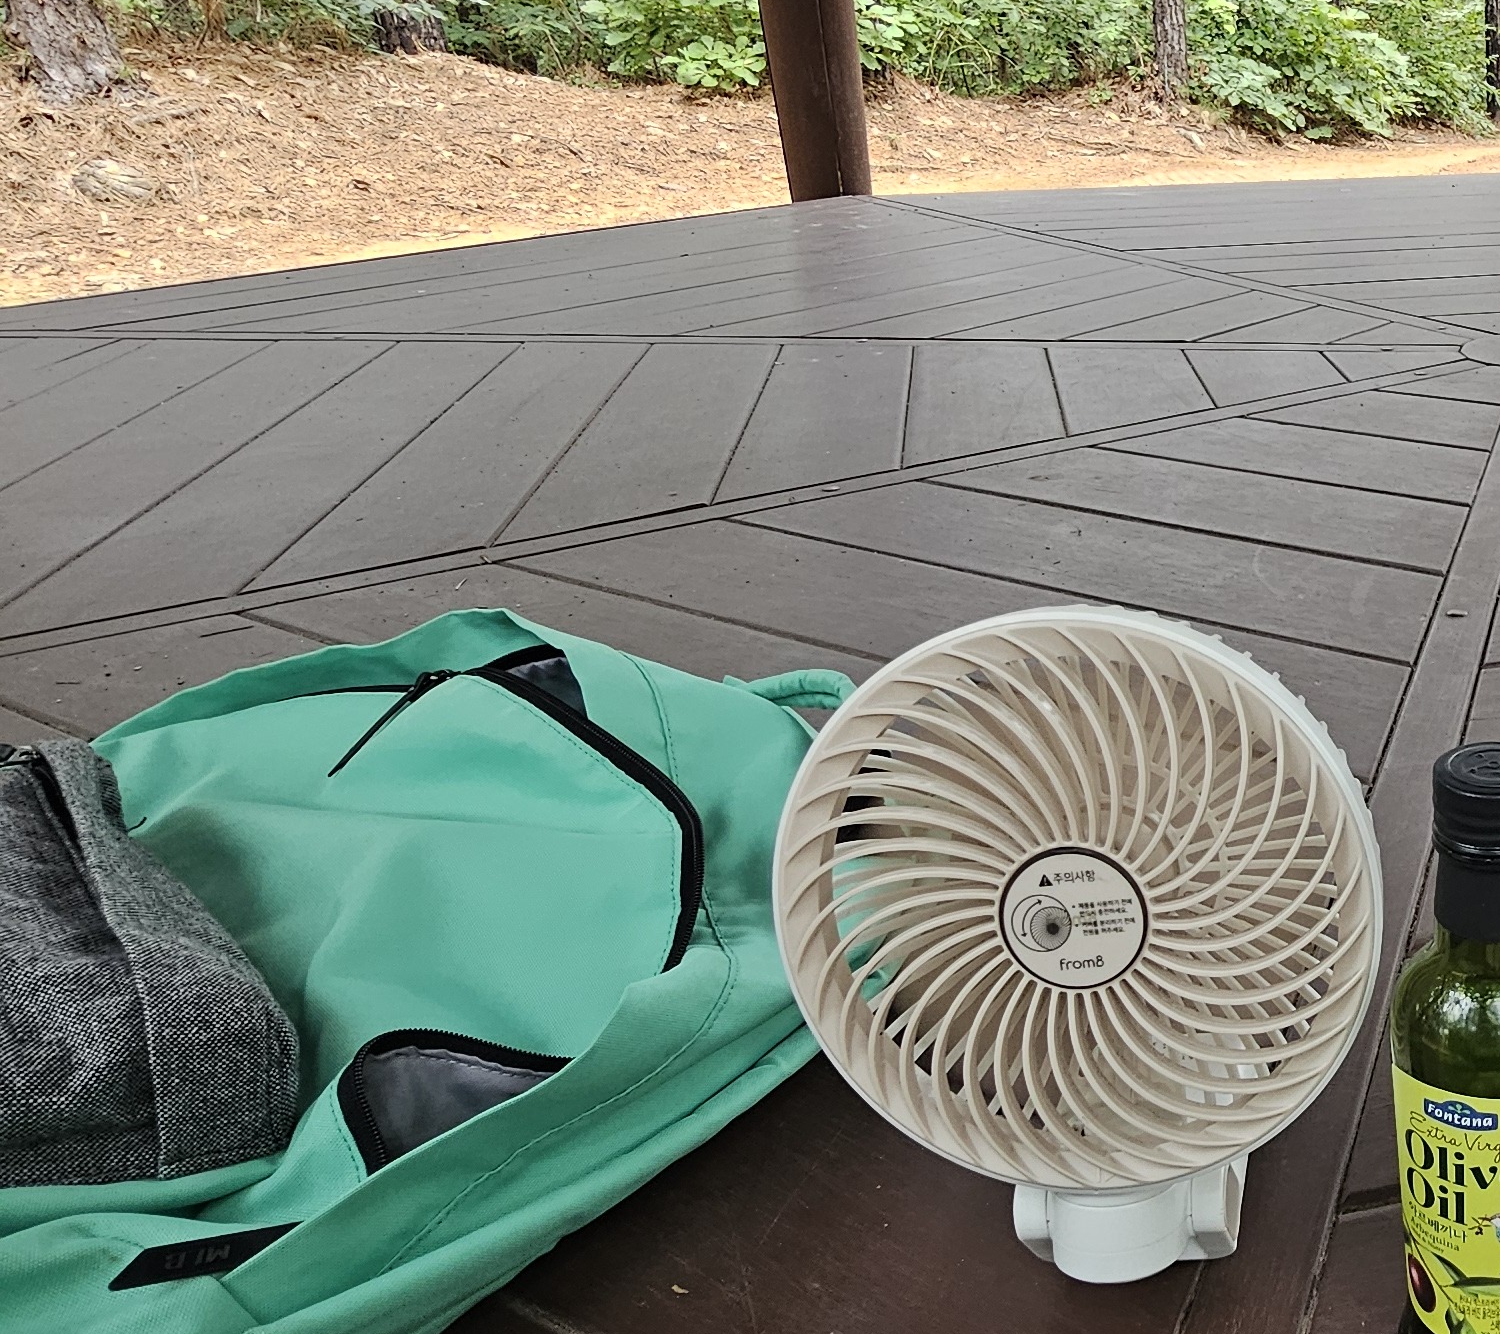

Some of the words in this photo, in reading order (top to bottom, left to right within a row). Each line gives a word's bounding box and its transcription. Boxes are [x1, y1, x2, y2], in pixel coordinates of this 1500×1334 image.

[1053, 870, 1096, 884] 주의사항
[1059, 955, 1105, 970] from8
[1427, 1104, 1493, 1127] Fontana
[1409, 1110, 1462, 1148] Extra
[1407, 1166, 1468, 1226] Oil
